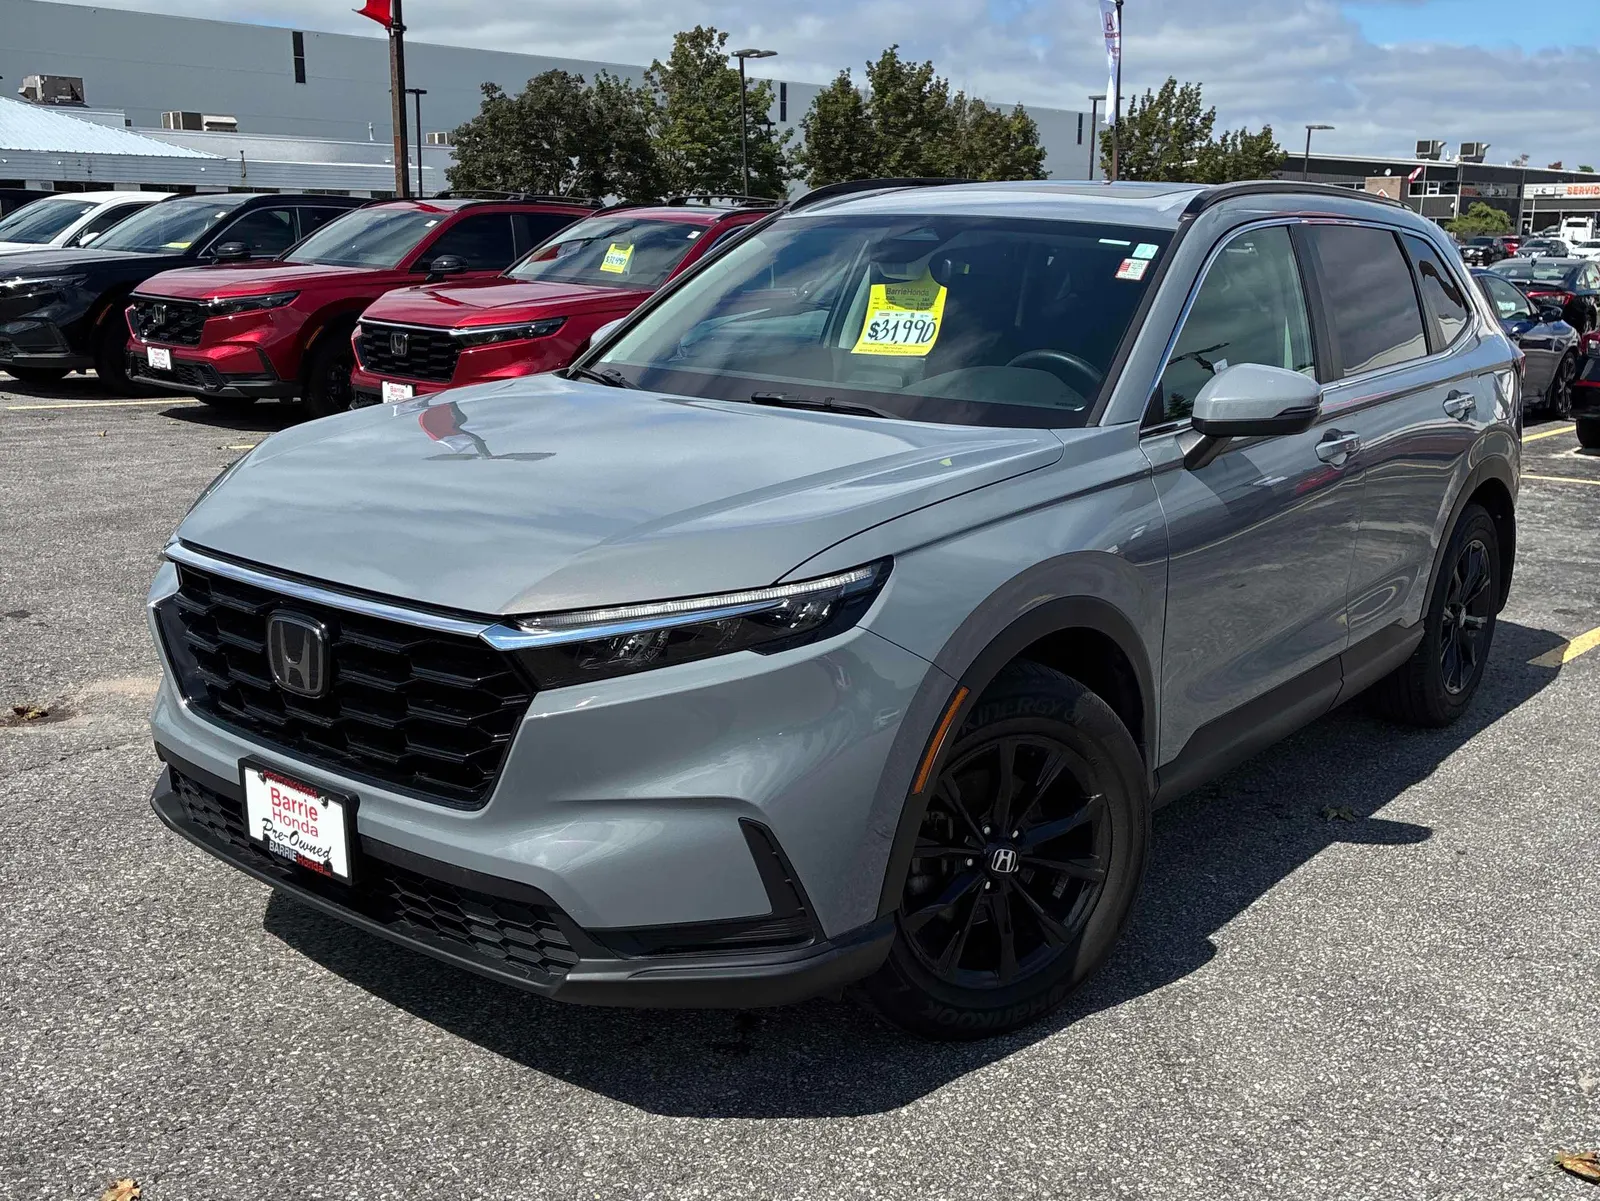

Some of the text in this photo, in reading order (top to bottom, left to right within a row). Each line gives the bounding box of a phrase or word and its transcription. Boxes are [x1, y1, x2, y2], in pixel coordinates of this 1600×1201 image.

[868, 319, 937, 344] $31,990
[270, 786, 318, 822] Barrie
[272, 807, 319, 838] Honda
[261, 818, 332, 861] Pre-Owned
